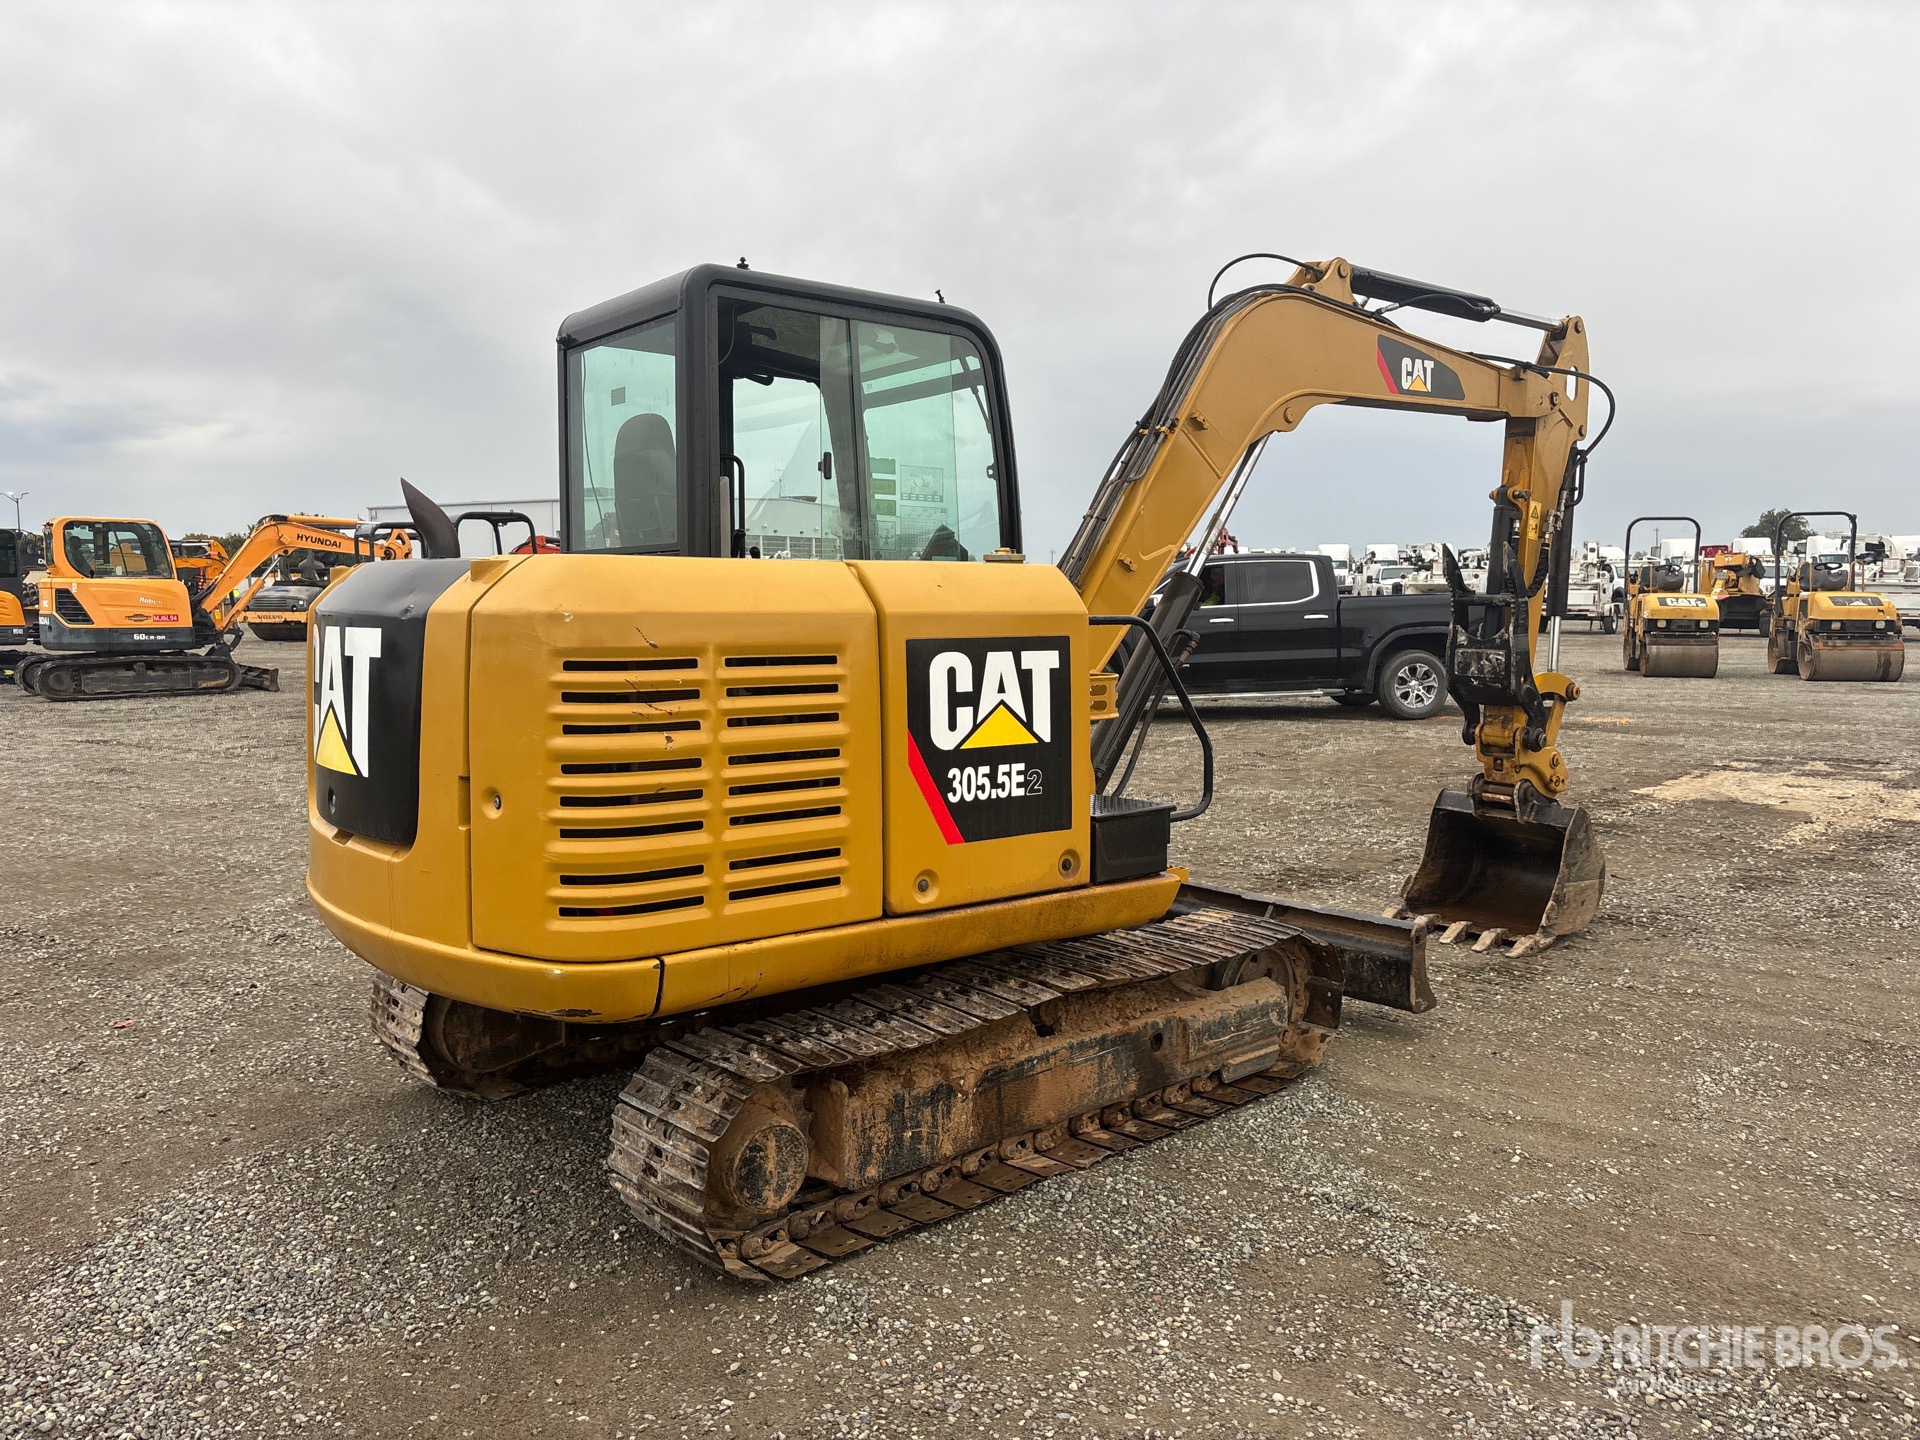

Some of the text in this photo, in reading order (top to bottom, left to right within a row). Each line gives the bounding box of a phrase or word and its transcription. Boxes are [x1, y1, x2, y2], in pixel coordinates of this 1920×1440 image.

[1401, 356, 1435, 393] CAT
[296, 533, 342, 549] HYUNDAI
[929, 650, 1060, 751] CAT
